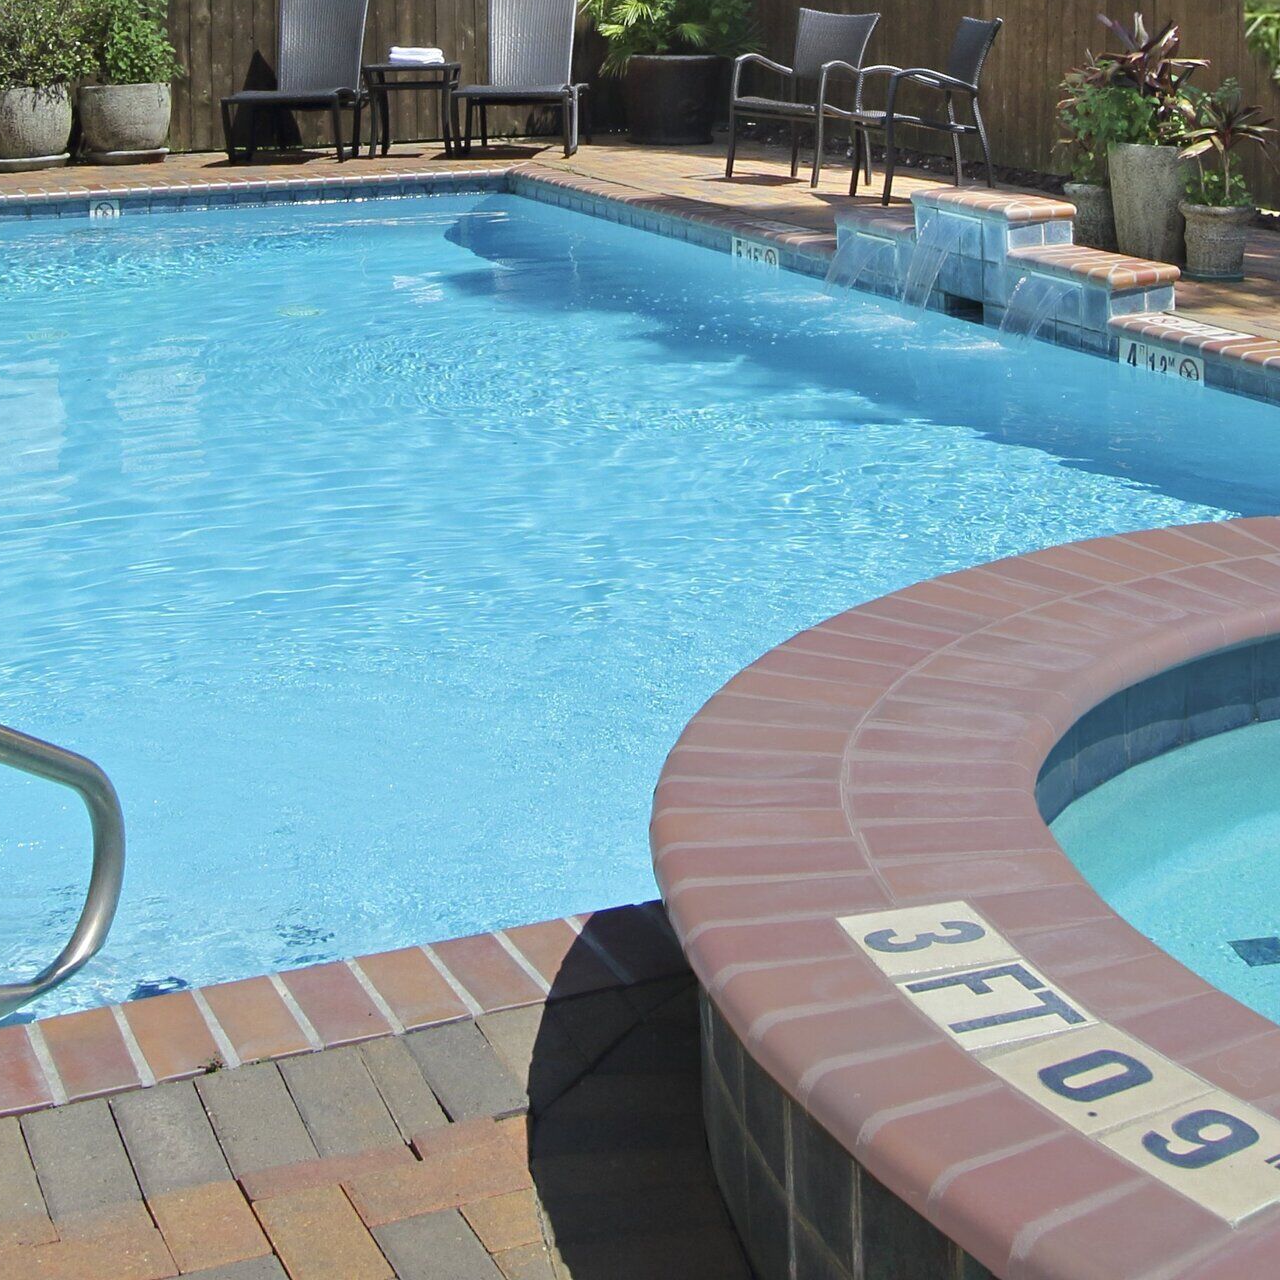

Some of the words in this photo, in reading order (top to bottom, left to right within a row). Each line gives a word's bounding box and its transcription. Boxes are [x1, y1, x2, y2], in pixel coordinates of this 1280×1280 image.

[1127, 342, 1137, 367] 4
[864, 920, 986, 953] 3
[906, 962, 1088, 1035] FT
